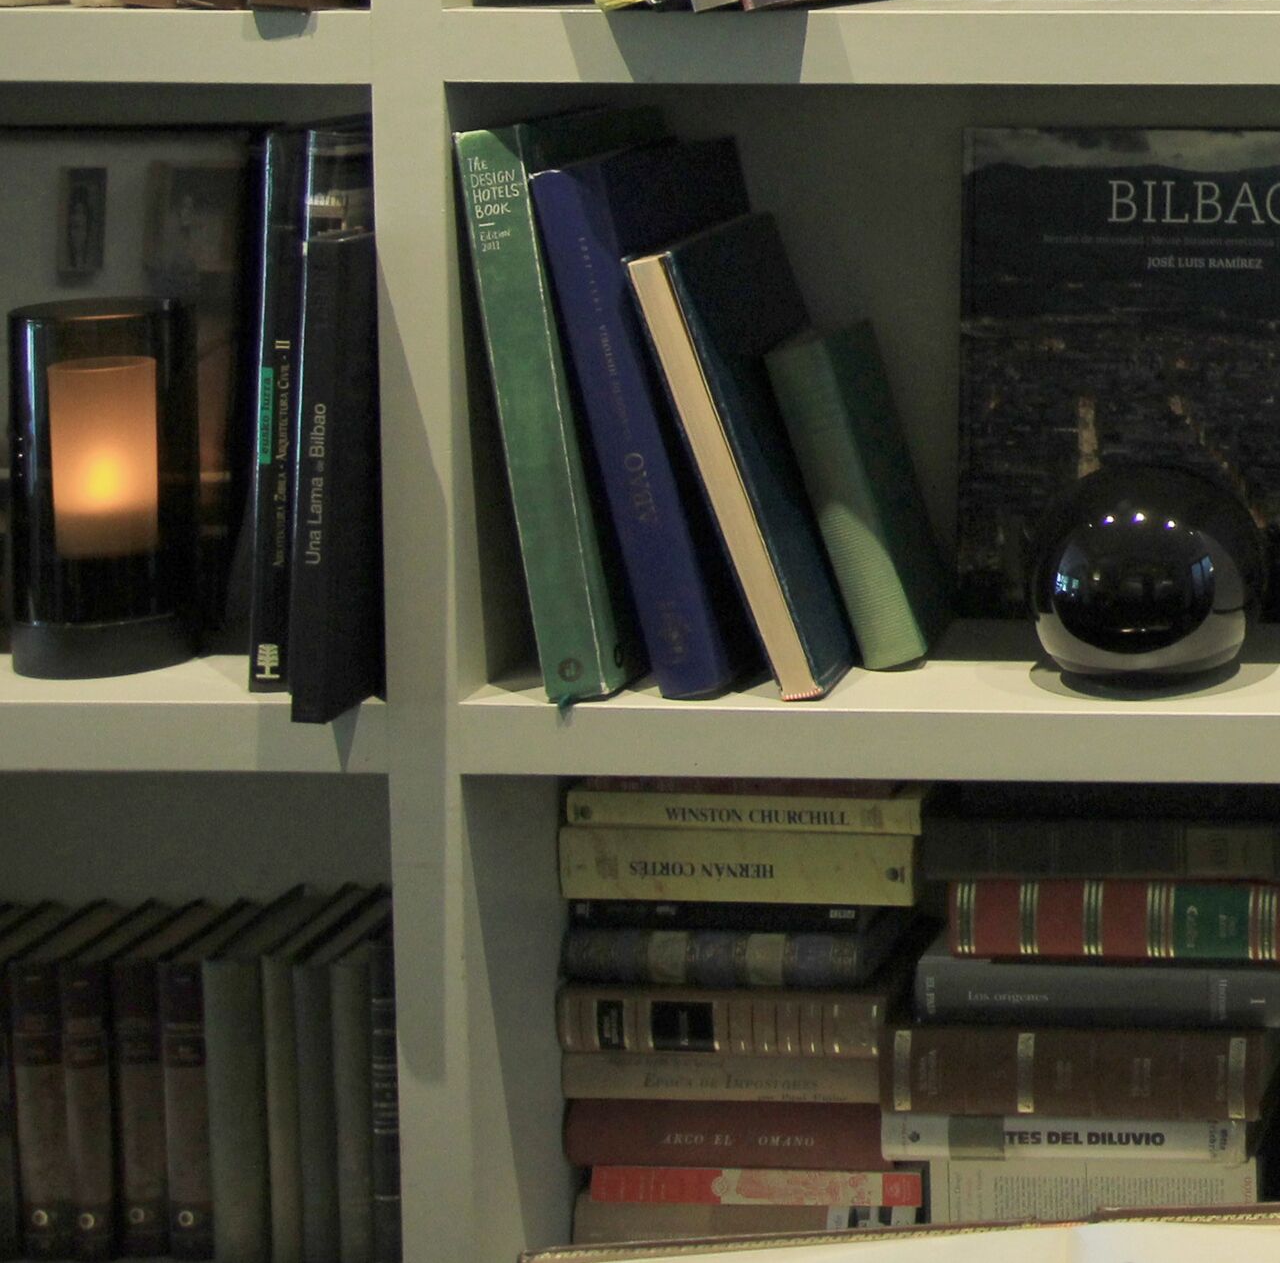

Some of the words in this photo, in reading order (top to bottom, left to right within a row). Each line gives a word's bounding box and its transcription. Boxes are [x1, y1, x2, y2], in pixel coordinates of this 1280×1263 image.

[308, 402, 326, 457] Bilbao
[307, 476, 323, 524] Lama
[305, 530, 321, 564] Una
[665, 808, 741, 822] WINSTON
[748, 809, 848, 824] CHURCHILL
[629, 861, 694, 879] CORTÉS
[701, 862, 773, 881] HERNÁN
[1047, 1131, 1083, 1145] DEL
[1087, 1131, 1165, 1146] DILUVIO
